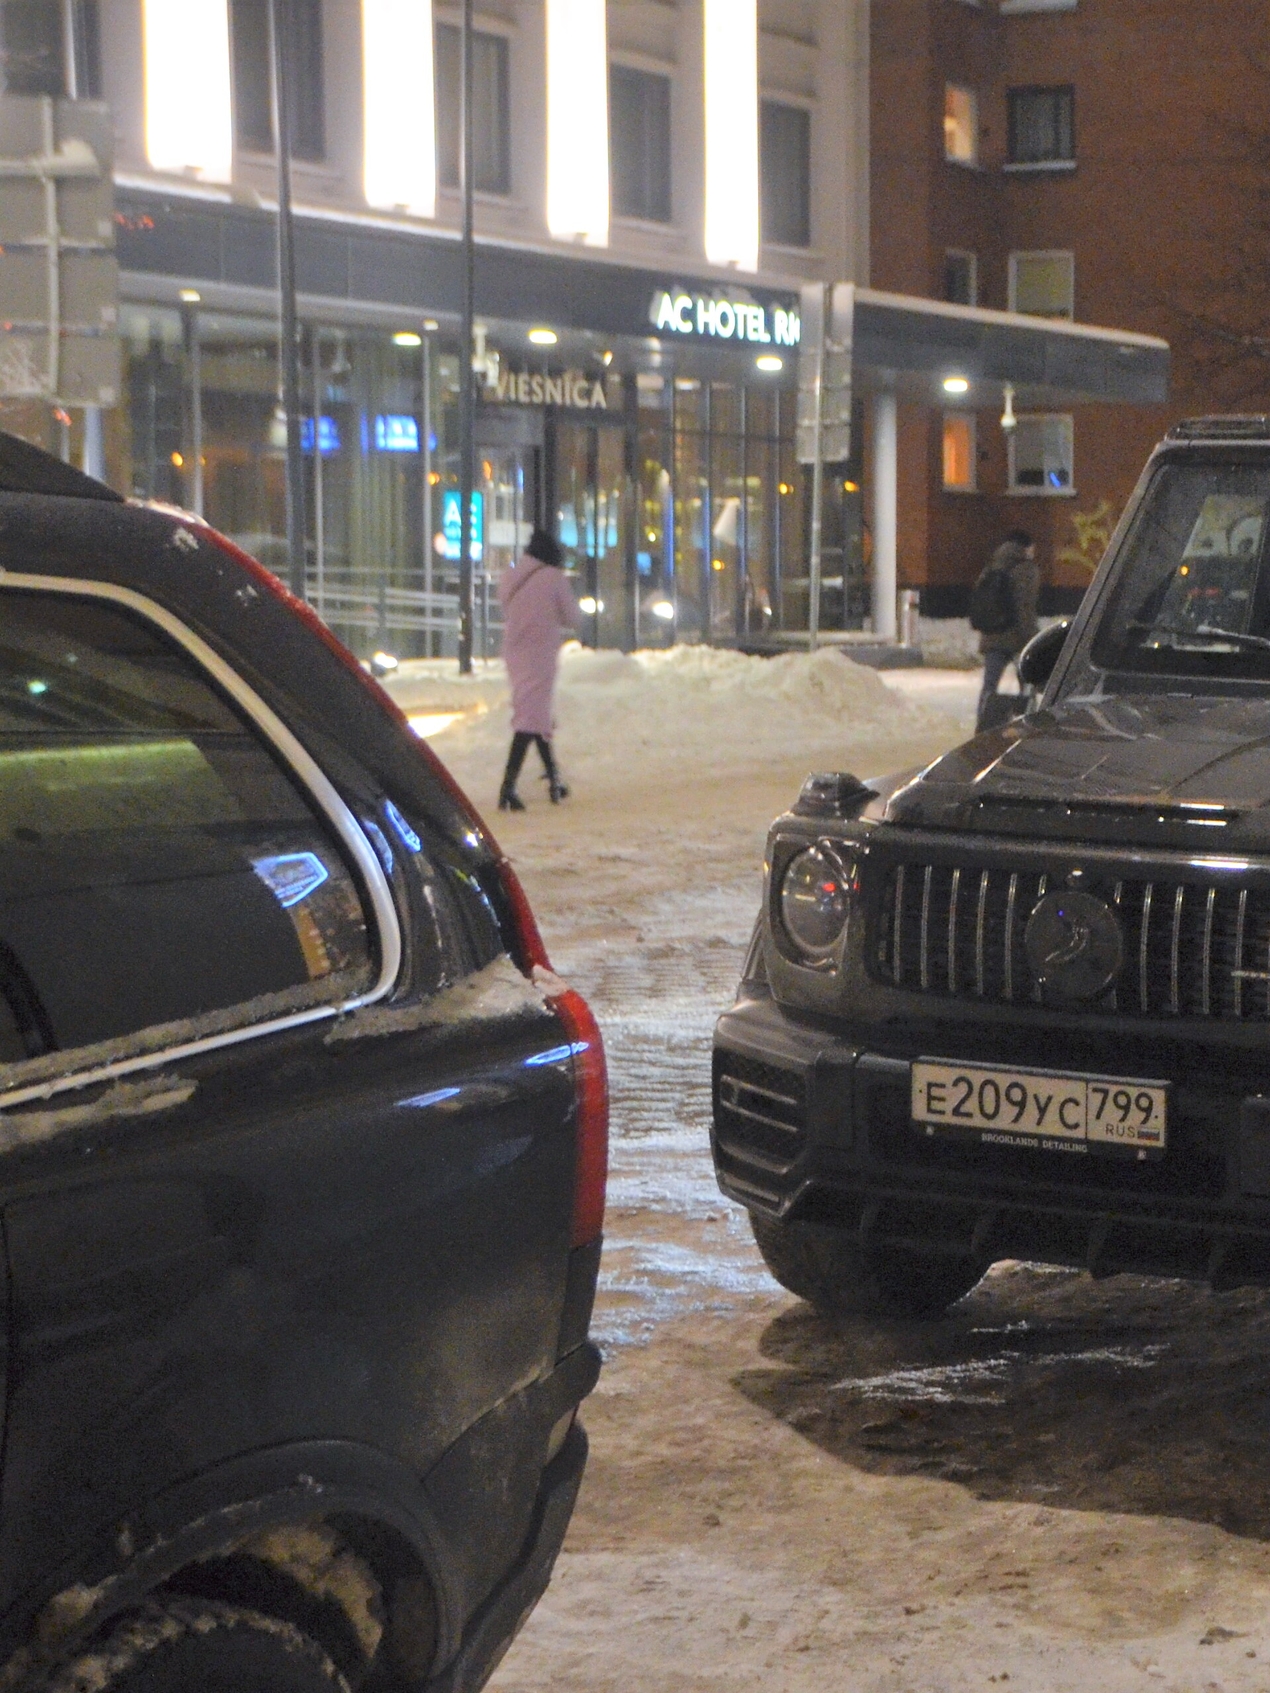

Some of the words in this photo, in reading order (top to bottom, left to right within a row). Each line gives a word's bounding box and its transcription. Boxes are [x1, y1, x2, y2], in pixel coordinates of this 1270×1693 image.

[657, 293, 693, 333] AC
[697, 299, 771, 343] HOTEL
[1092, 1087, 1154, 1125] 799
[981, 1133, 1038, 1147] BROOKLANDS
[1043, 1140, 1088, 1153] DETAILING
[1105, 1123, 1136, 1139] RUS
